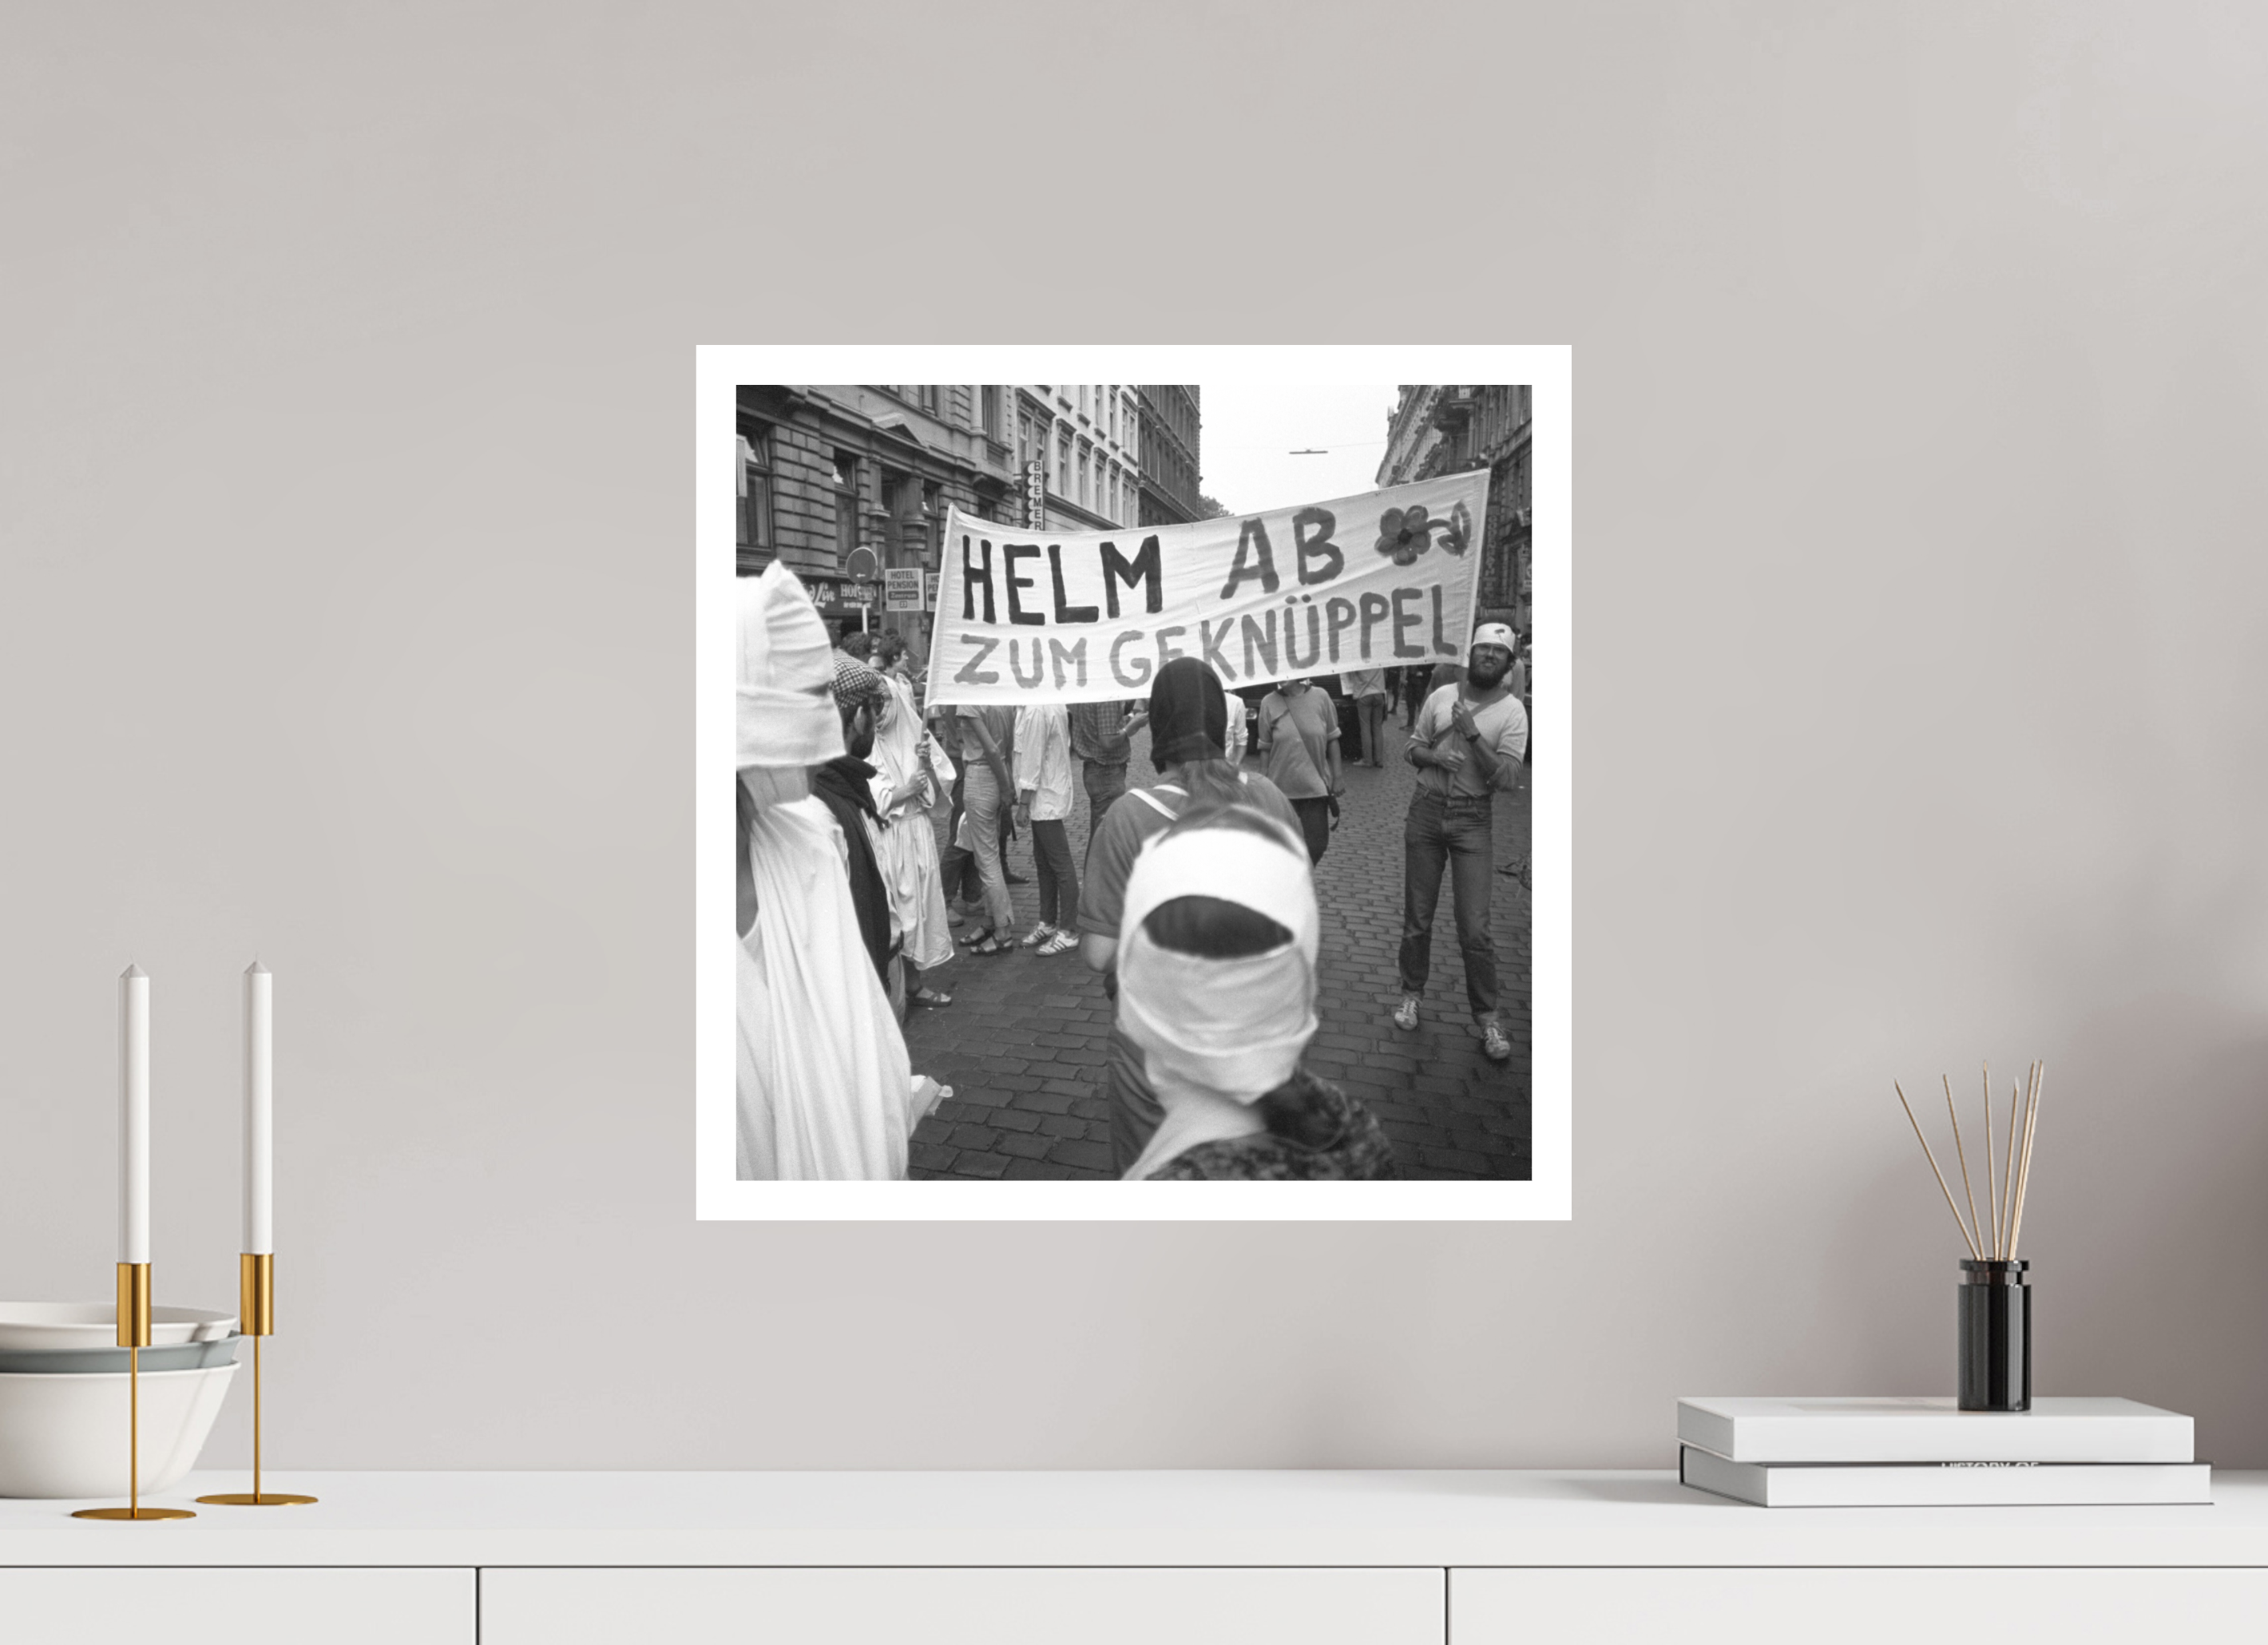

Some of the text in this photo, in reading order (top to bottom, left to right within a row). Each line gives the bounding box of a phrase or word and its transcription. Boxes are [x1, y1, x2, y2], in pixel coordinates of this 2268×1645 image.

[1033, 461, 1042, 531] BREMER
[887, 581, 919, 589] PENSION
[890, 570, 914, 580] HOTEL
[963, 507, 1345, 626] HELM AB
[953, 585, 1458, 689] ZUM GEKNÜPPEL
